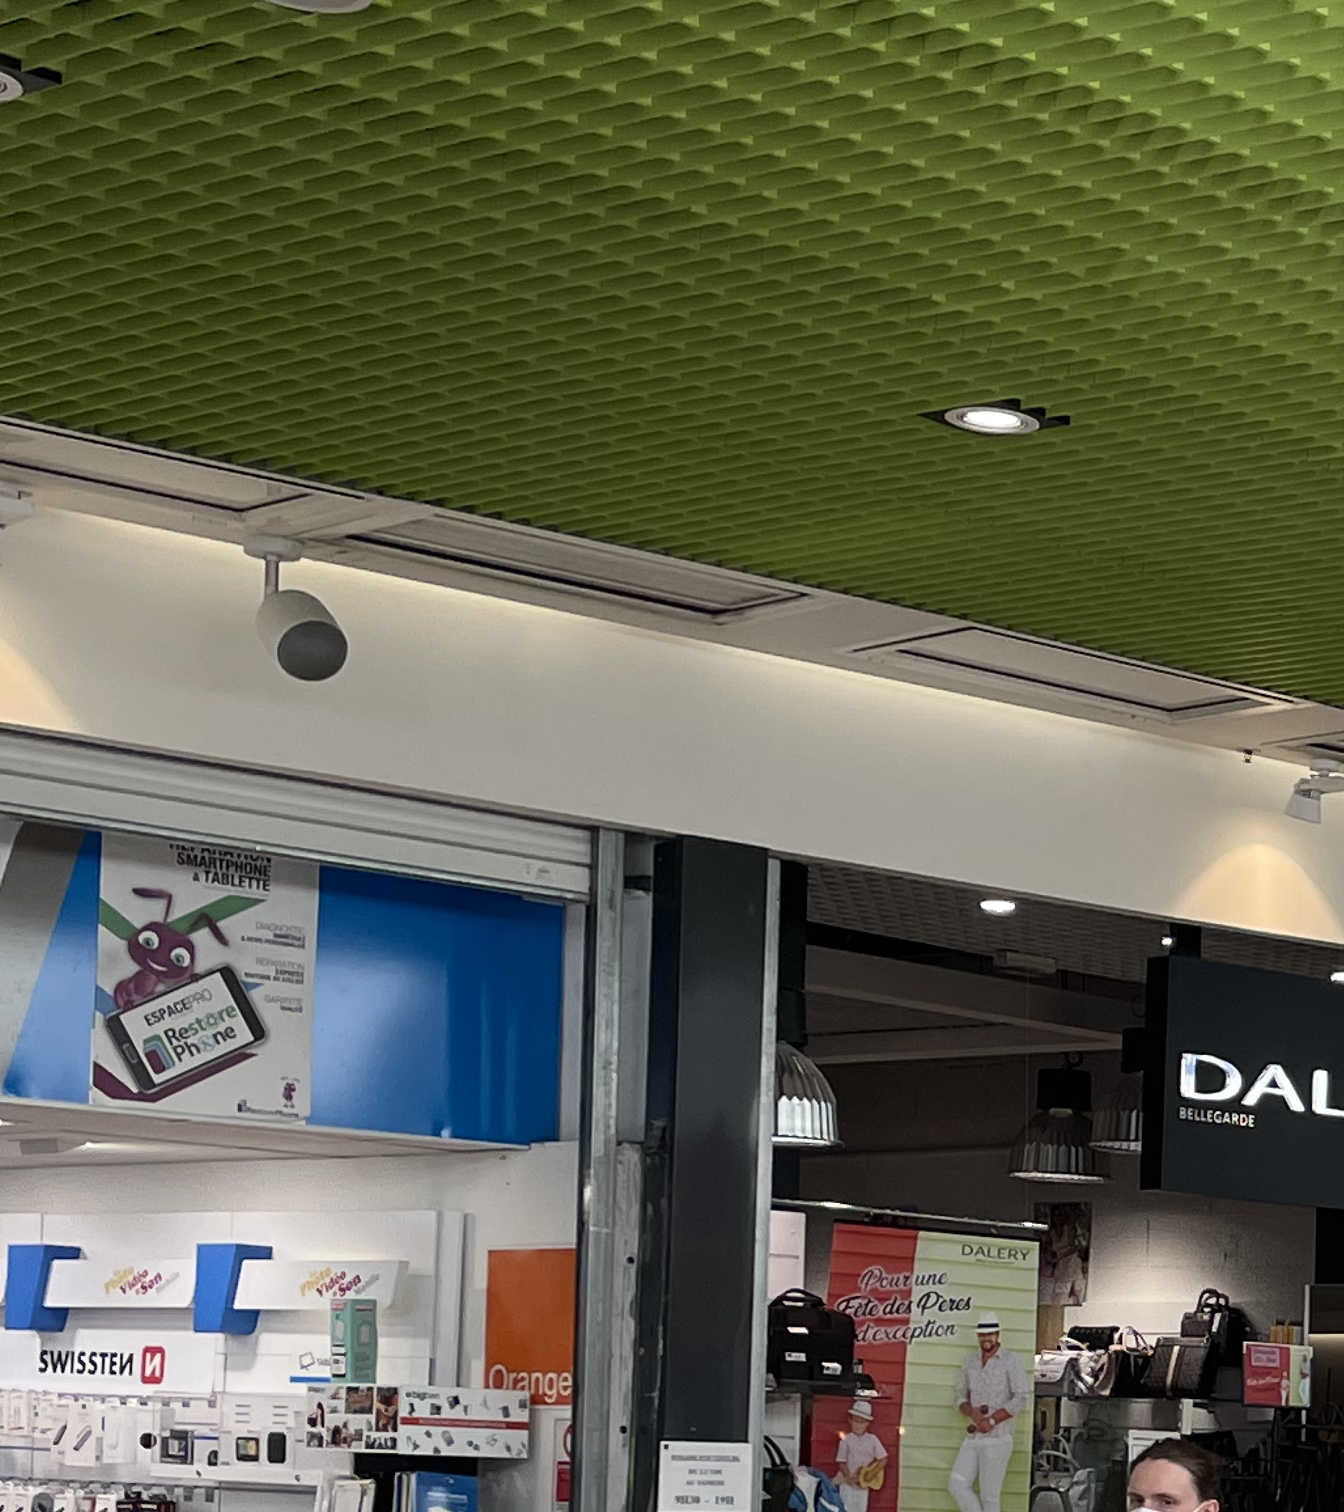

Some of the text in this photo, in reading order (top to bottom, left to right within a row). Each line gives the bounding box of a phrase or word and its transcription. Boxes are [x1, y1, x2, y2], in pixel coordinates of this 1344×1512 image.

[176, 851, 272, 878] SMARTPHONE
[203, 869, 271, 892] TABLETTE
[163, 1004, 237, 1045] Restore
[1179, 1106, 1256, 1128] BELLEGARDE
[960, 1244, 1030, 1261] DALERY
[859, 1265, 948, 1293] Pour une
[883, 1295, 913, 1315] des
[489, 1365, 572, 1403] Orange
